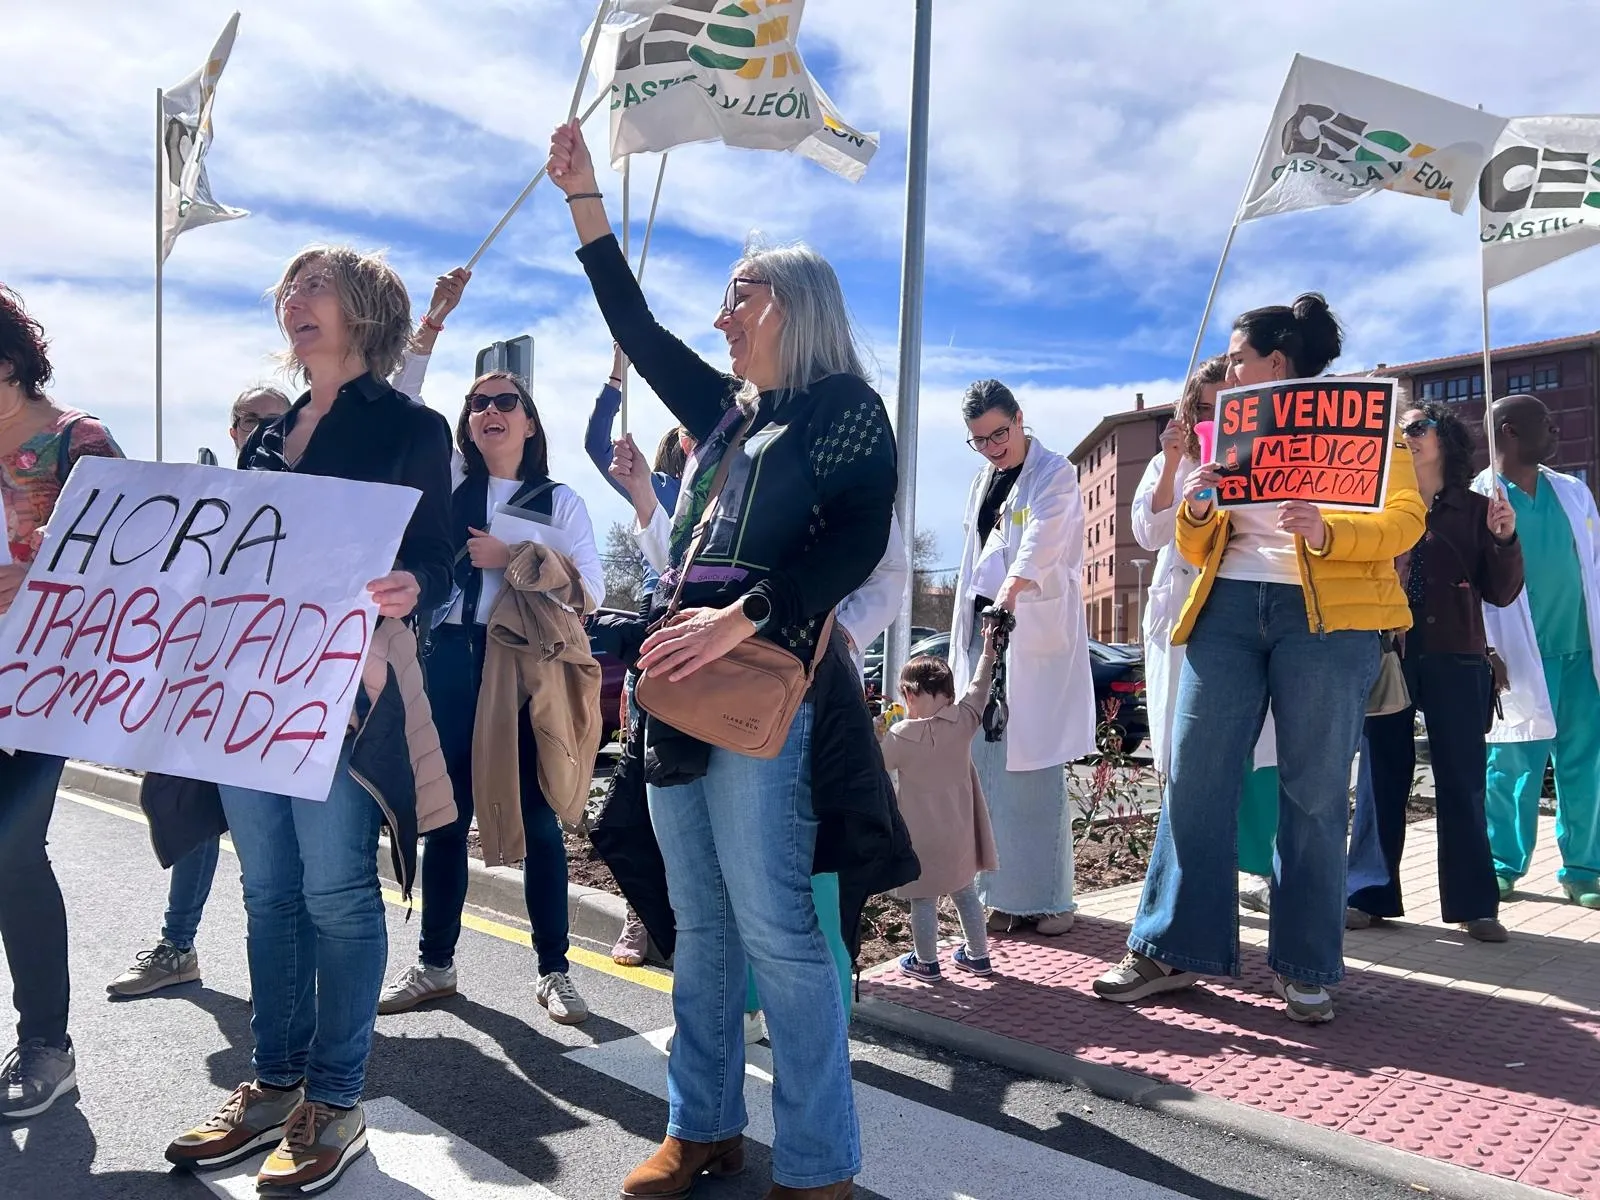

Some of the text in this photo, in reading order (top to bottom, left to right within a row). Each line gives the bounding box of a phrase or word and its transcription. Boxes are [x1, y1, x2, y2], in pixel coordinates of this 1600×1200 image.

[1223, 390, 1385, 435] SE VENDE
[1251, 467, 1378, 497] VOCACIÓN
[48, 488, 286, 585] HORA
[16, 580, 367, 704] TRABAJADA
[0, 662, 327, 774] COMPUTADA
